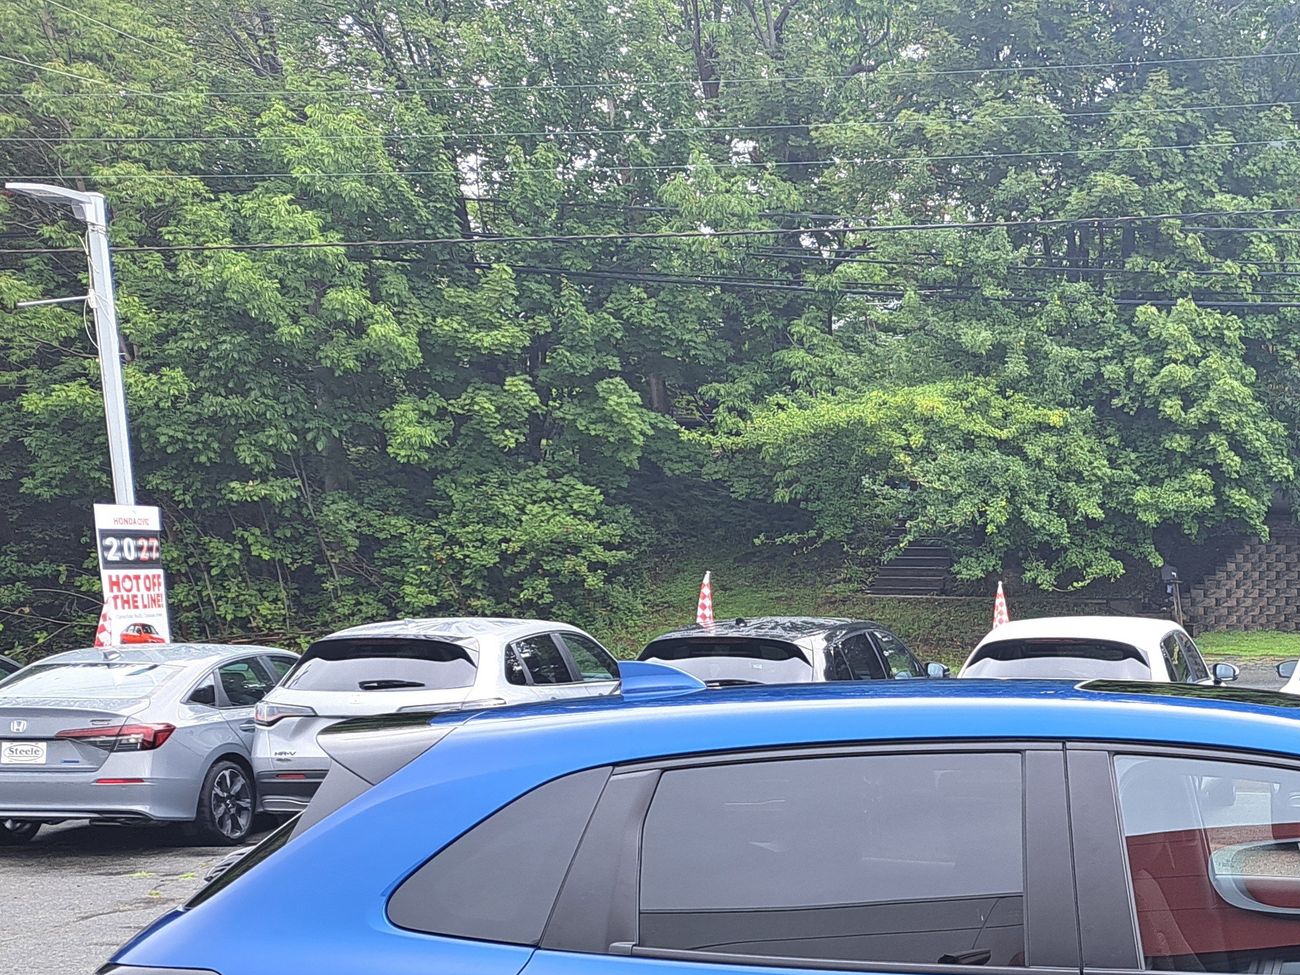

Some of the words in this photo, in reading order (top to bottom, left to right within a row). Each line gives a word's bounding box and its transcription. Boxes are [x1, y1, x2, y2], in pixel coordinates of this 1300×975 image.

[113, 517, 137, 526] HONDA
[108, 574, 141, 593] HOT
[143, 573, 161, 592] OFF
[112, 594, 140, 610] THE
[141, 593, 164, 609] LINE!
[8, 747, 40, 756] Steele
